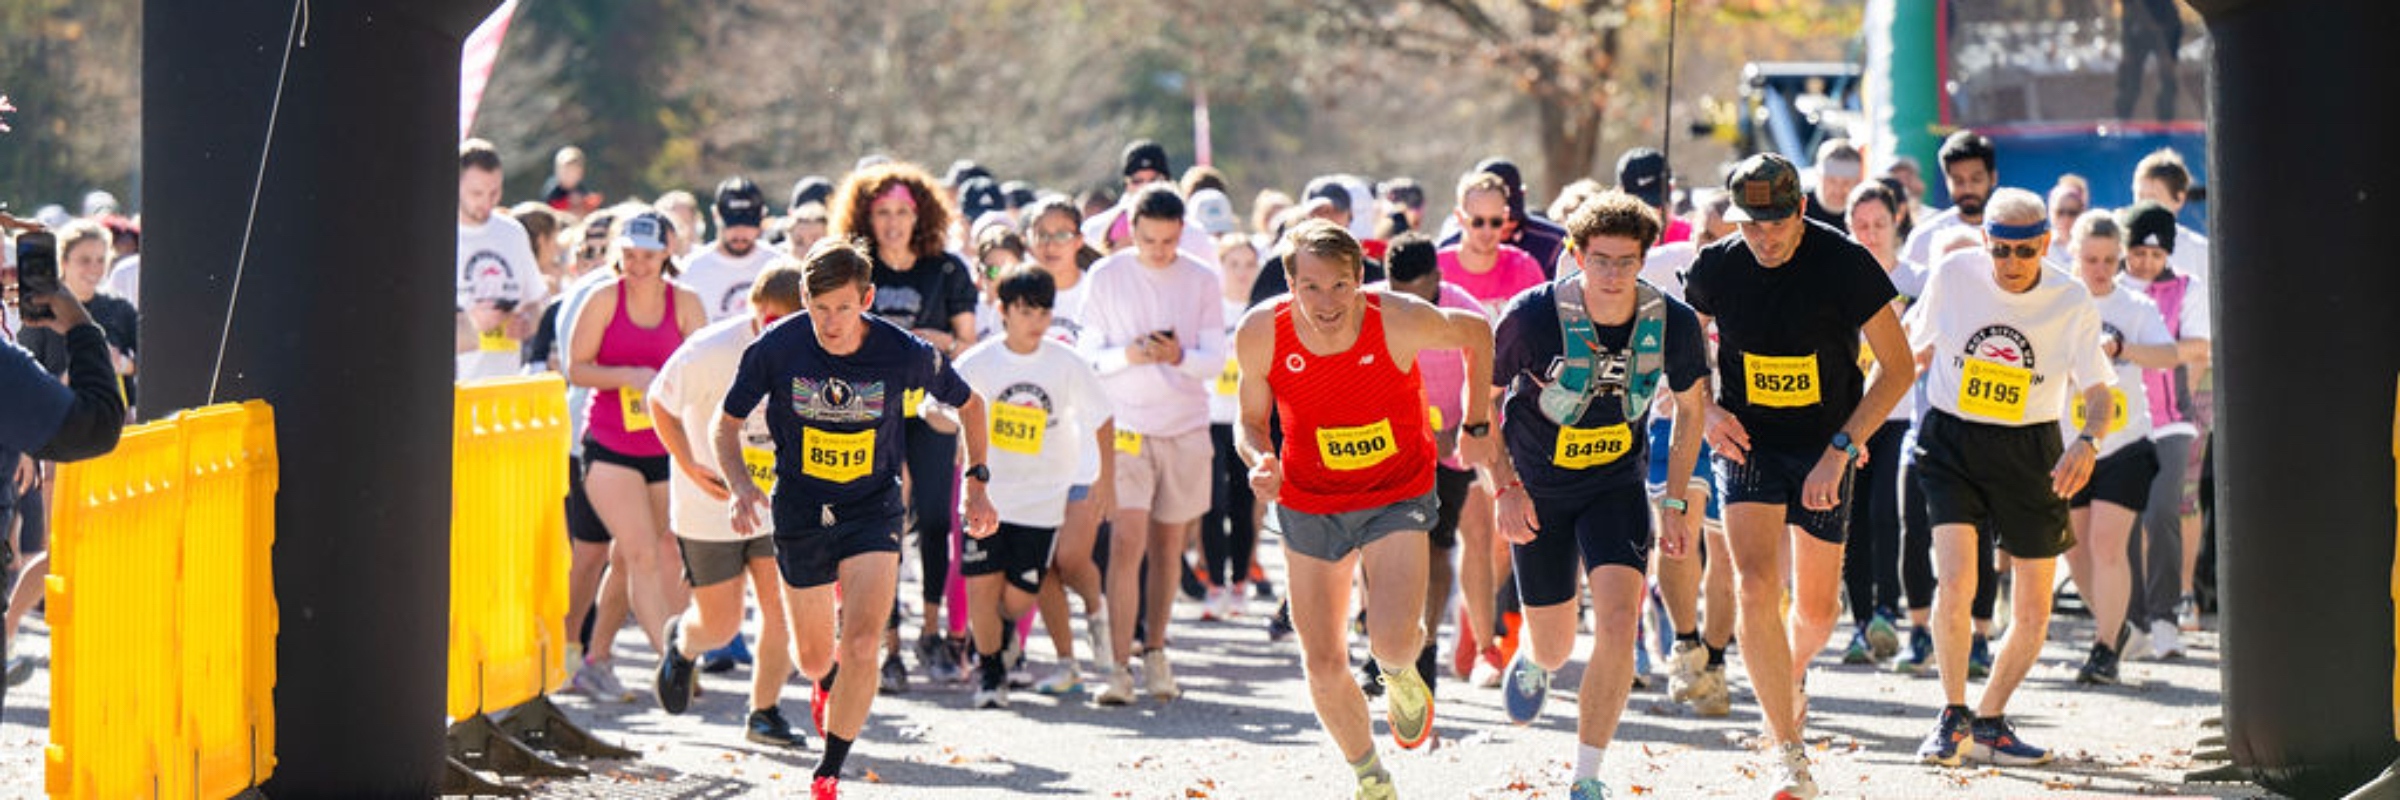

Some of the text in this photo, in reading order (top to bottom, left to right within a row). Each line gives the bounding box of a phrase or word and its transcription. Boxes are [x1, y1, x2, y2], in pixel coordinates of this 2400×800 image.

[1754, 372, 1810, 392] 8528
[1967, 377, 2021, 405] 8195
[994, 417, 1037, 440] 8531
[1327, 436, 1386, 457] 8490
[1565, 438, 1623, 458] 8498
[810, 447, 866, 468] 8519
